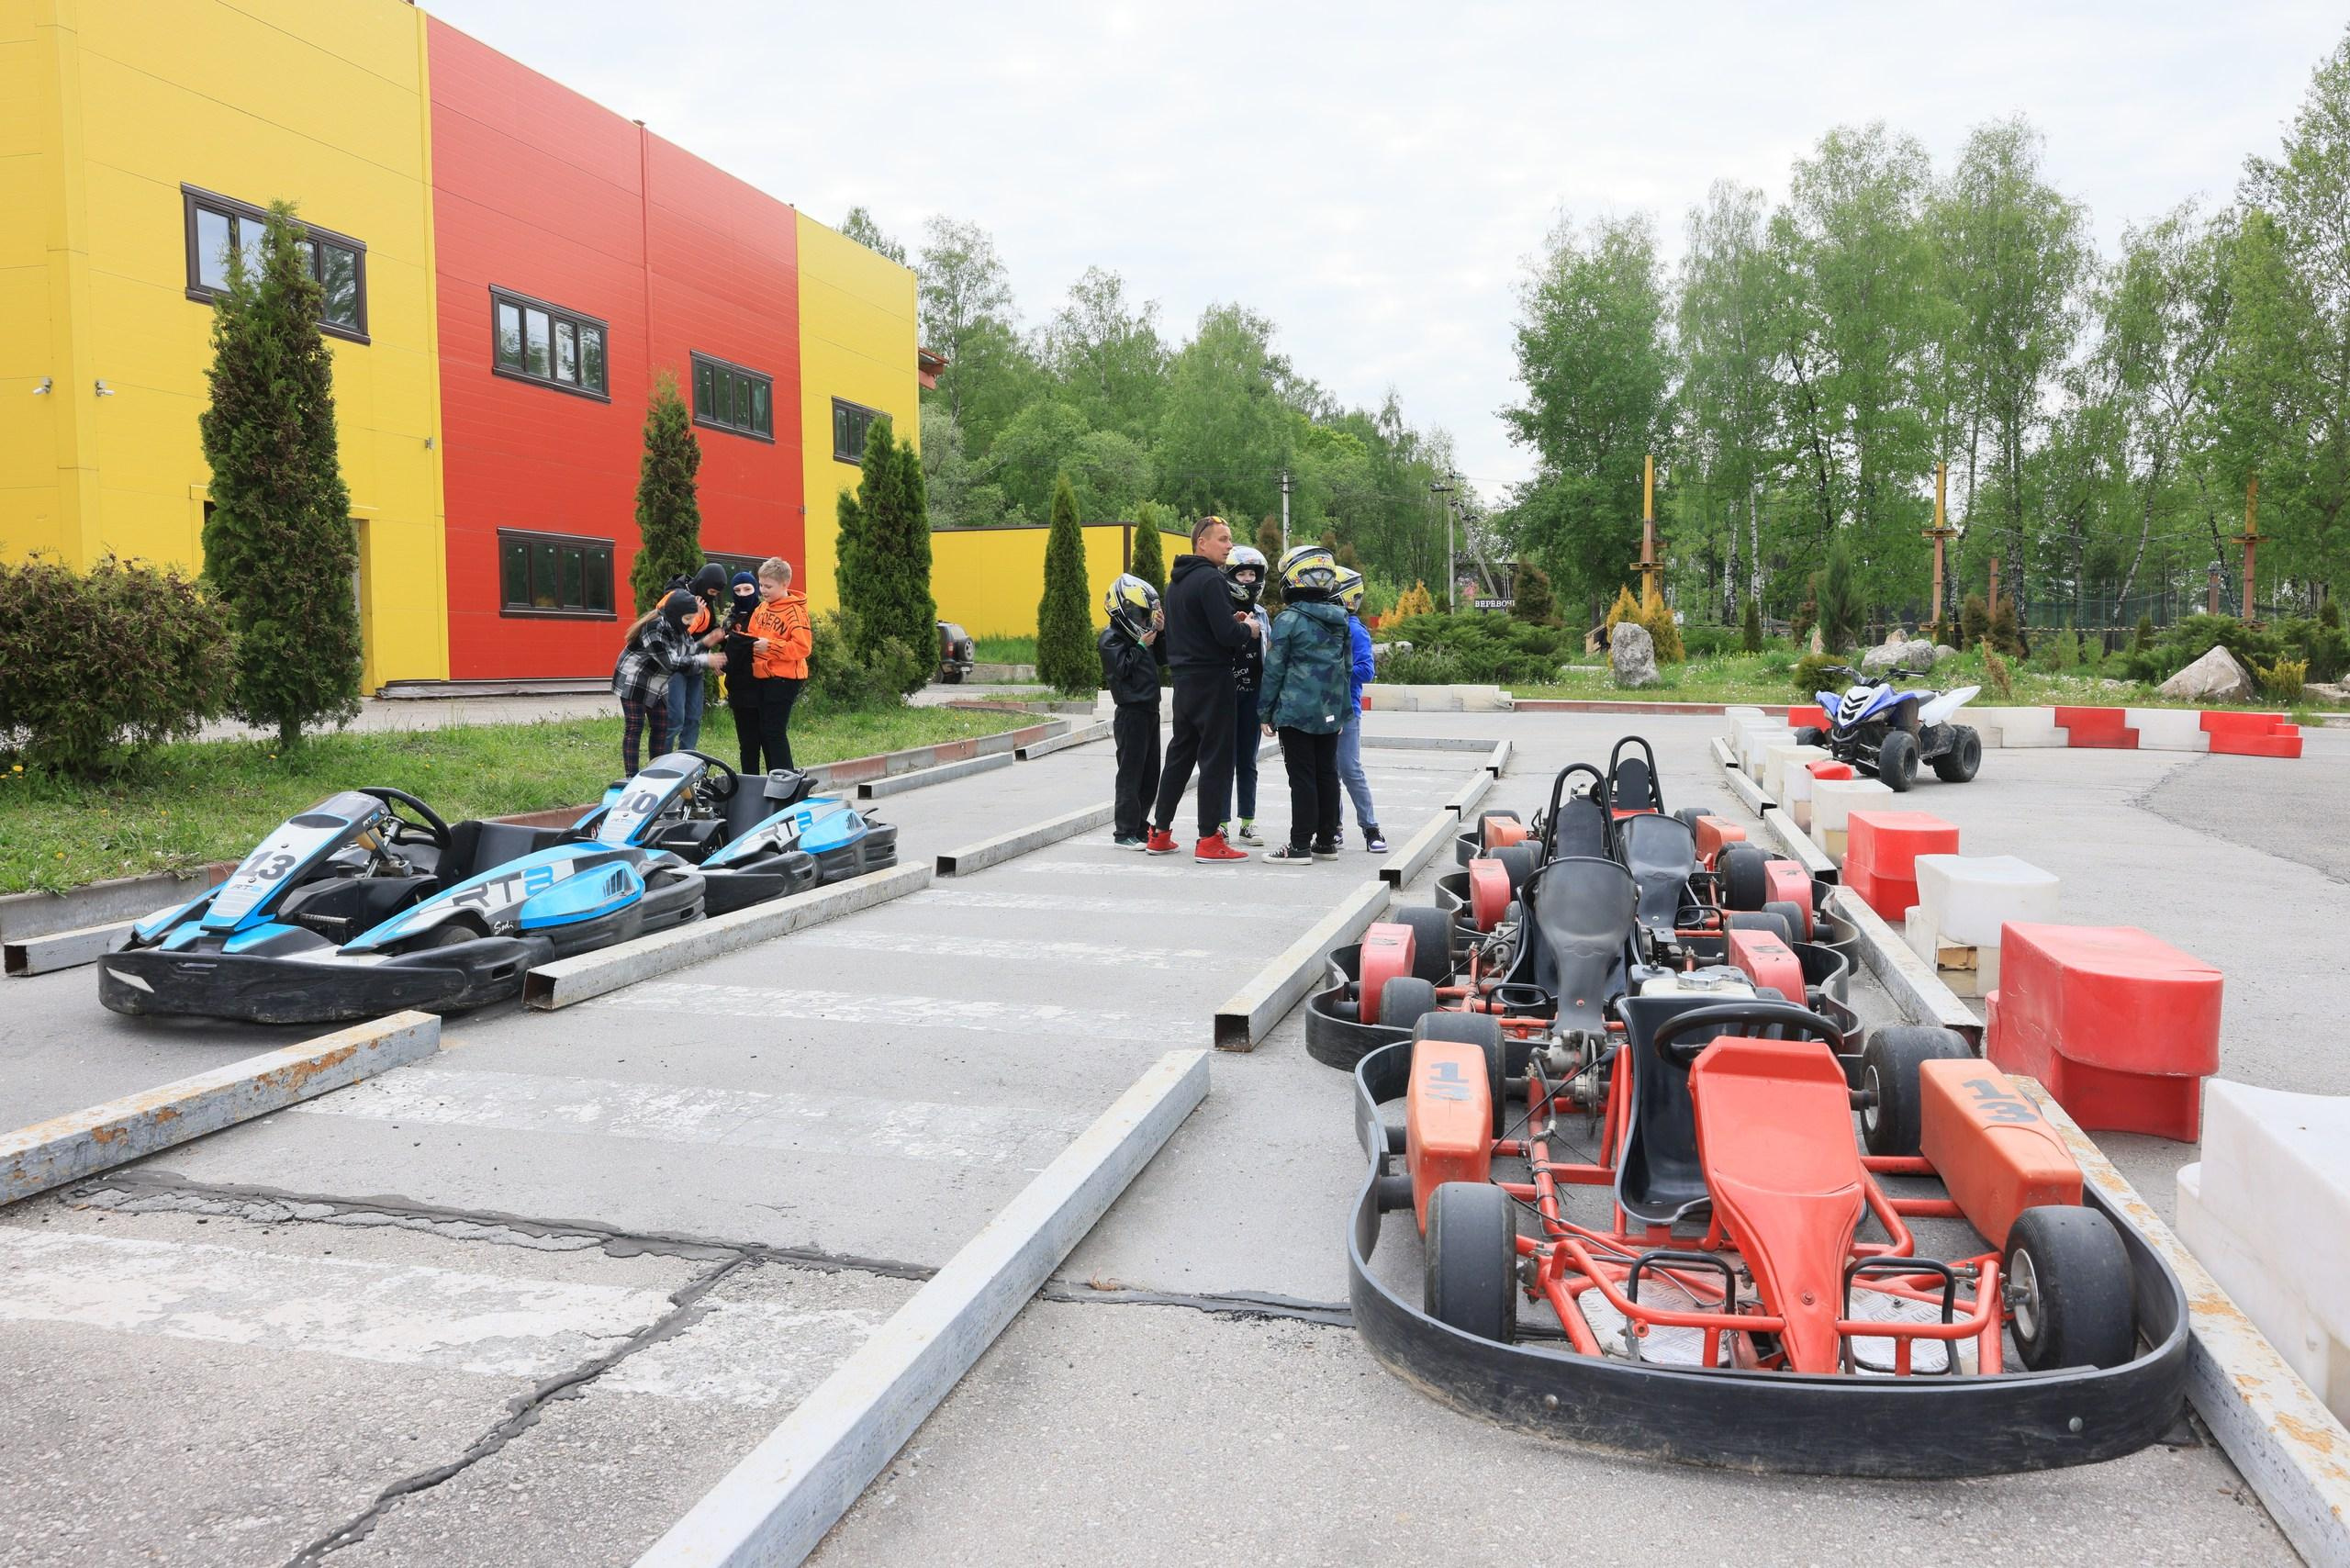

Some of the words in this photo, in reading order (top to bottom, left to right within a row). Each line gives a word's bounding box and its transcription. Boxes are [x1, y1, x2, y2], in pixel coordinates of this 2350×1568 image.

[613, 791, 659, 814] 10
[237, 851, 297, 880] 13
[452, 866, 554, 907] RT8
